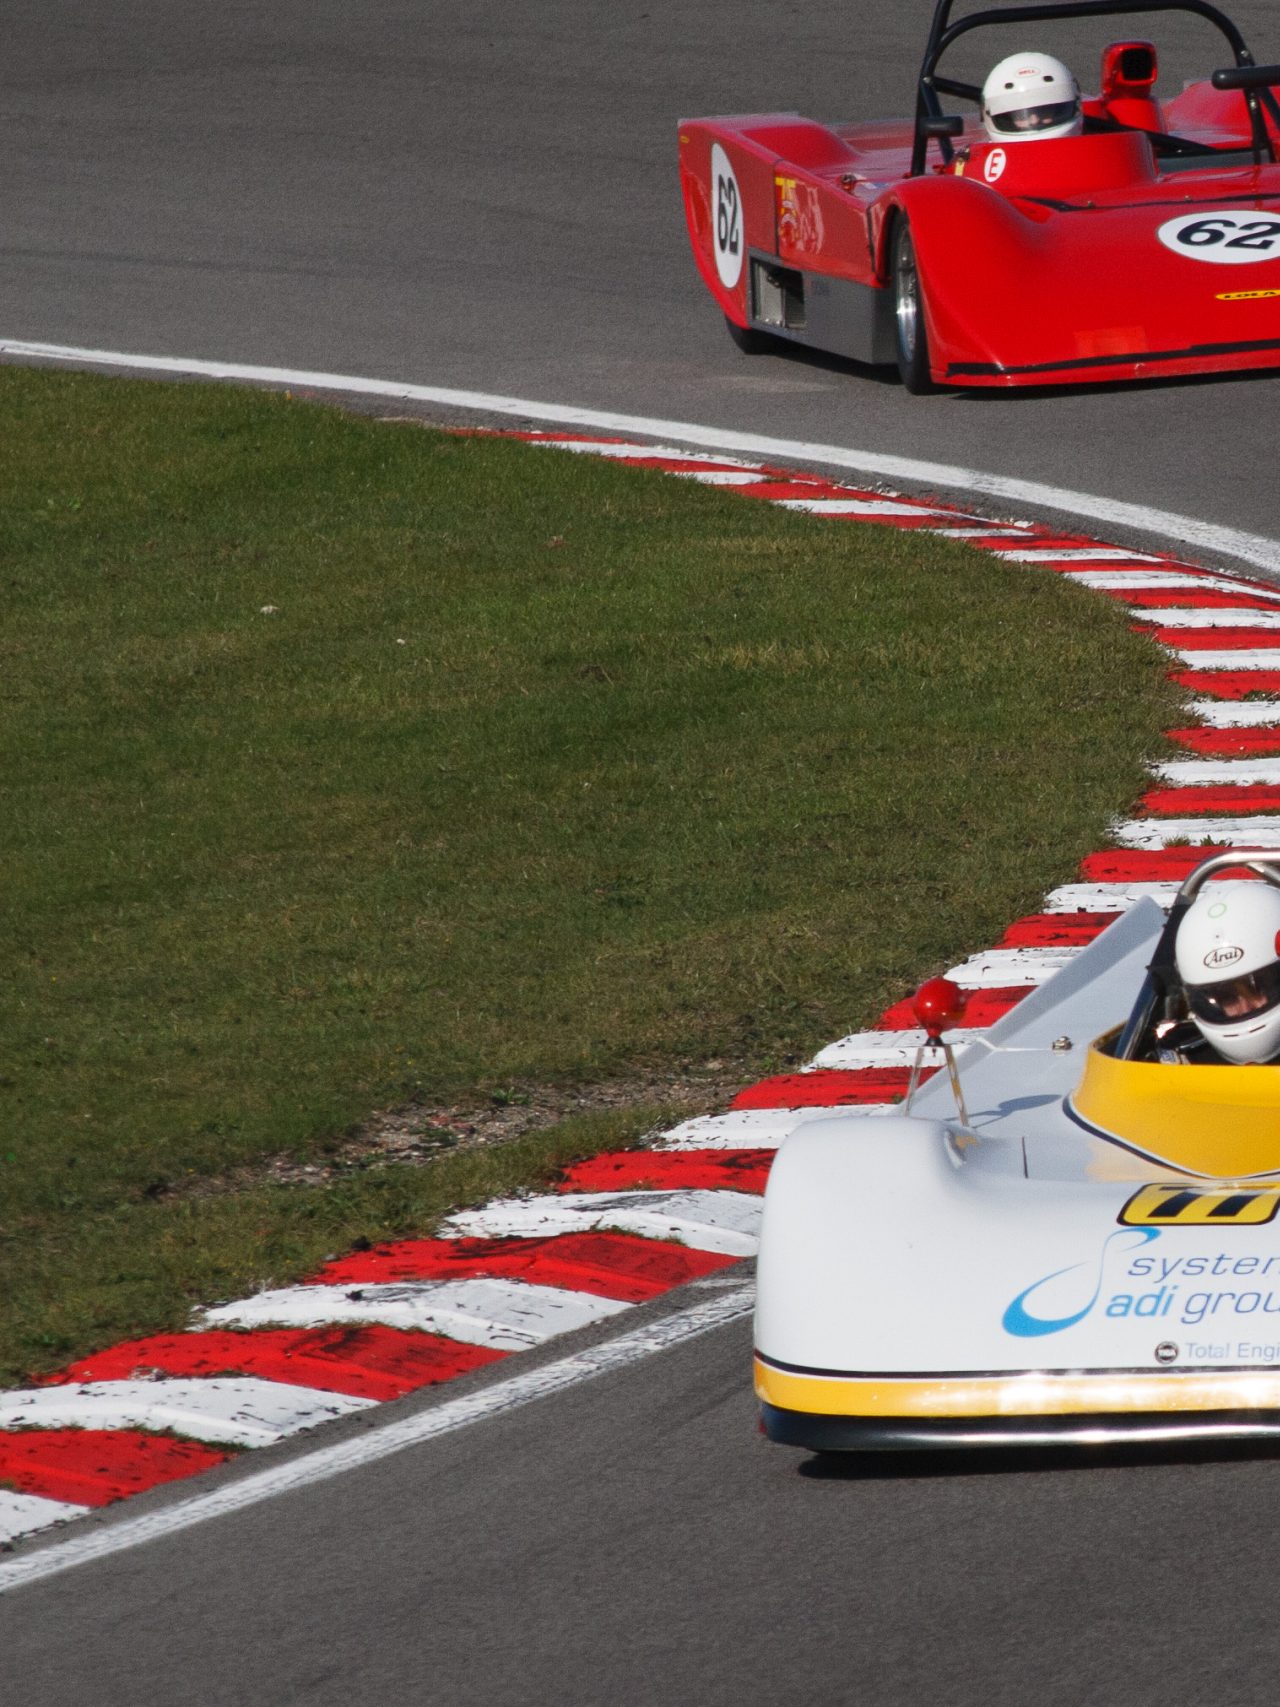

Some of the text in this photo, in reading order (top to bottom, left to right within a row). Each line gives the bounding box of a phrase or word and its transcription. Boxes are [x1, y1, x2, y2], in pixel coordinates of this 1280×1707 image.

[988, 152, 1002, 178] E
[718, 174, 738, 255] 62
[1207, 948, 1238, 964] Arai
[1146, 1185, 1277, 1218] 77
[1106, 1285, 1179, 1317] adi
[1185, 1342, 1230, 1359] Total
